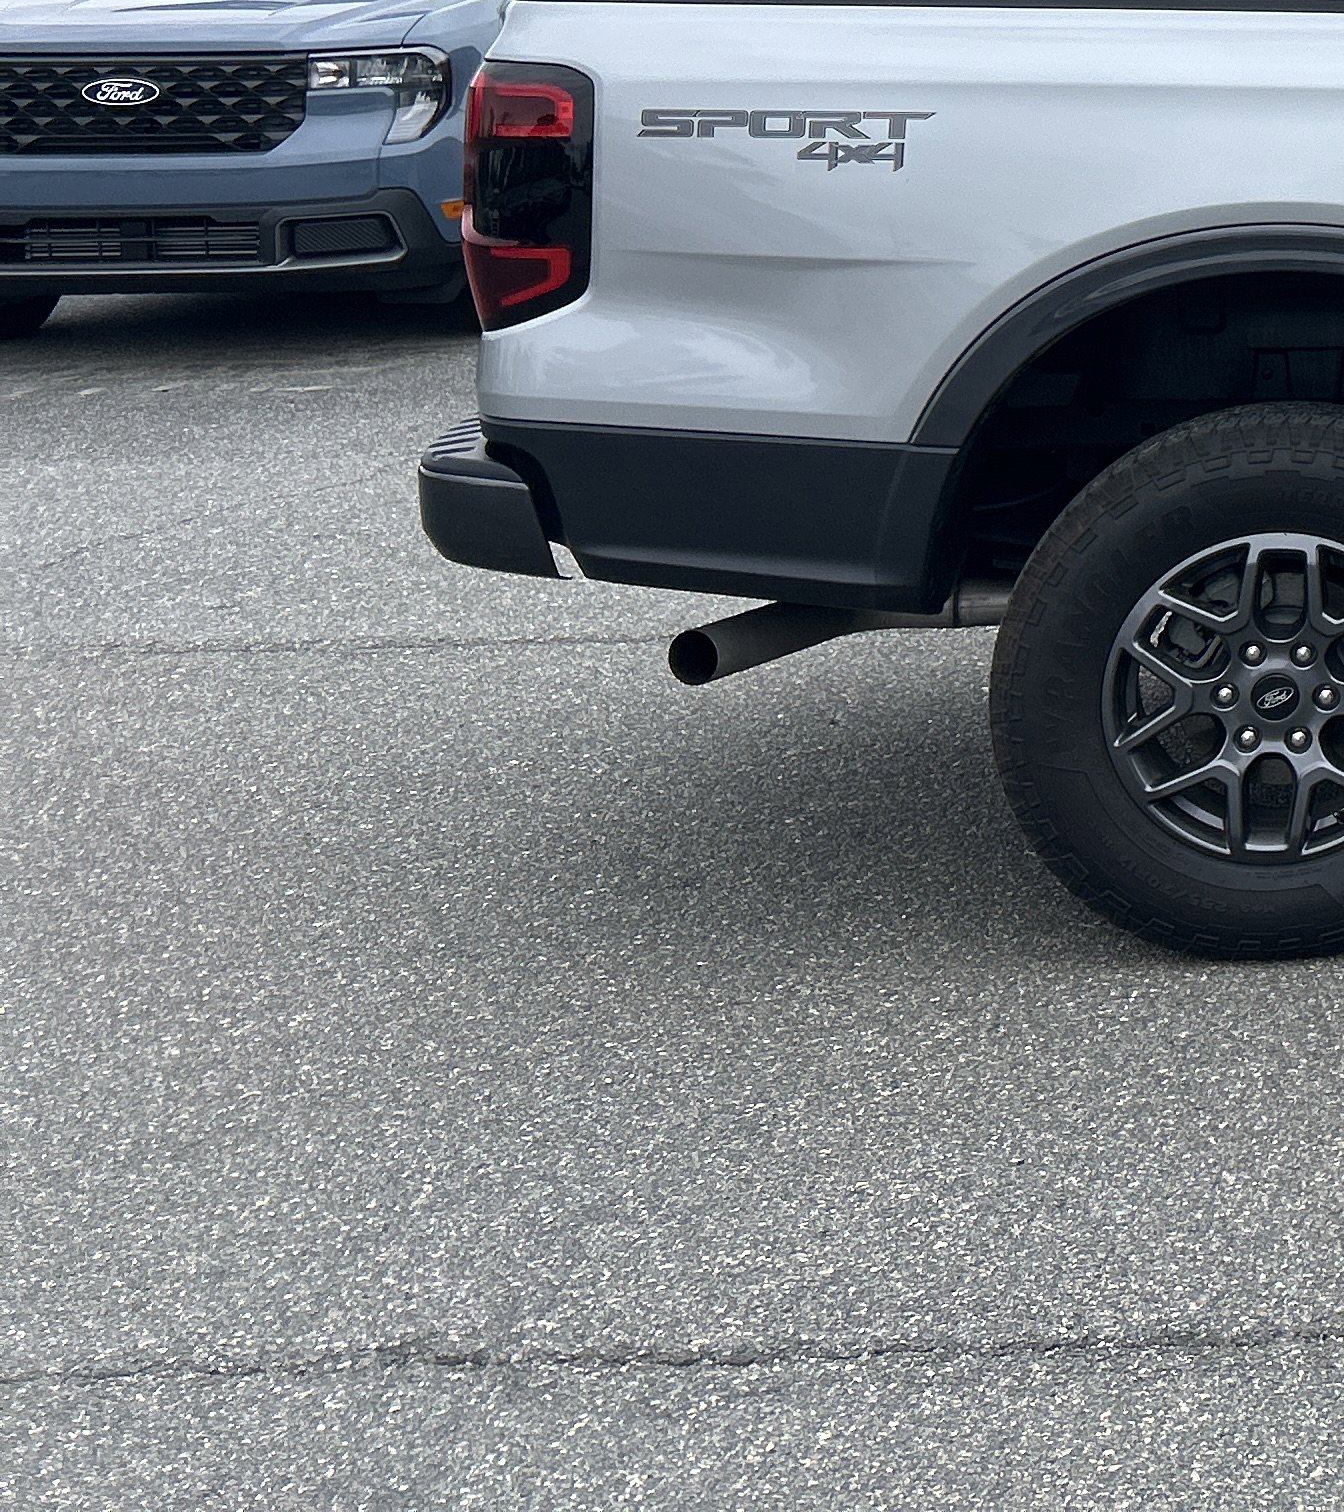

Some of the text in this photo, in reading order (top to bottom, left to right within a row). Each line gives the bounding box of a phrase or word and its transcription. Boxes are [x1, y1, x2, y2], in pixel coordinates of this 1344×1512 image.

[96, 82, 145, 101] Ford
[637, 108, 937, 140] SPORT
[796, 141, 905, 172] 4x4
